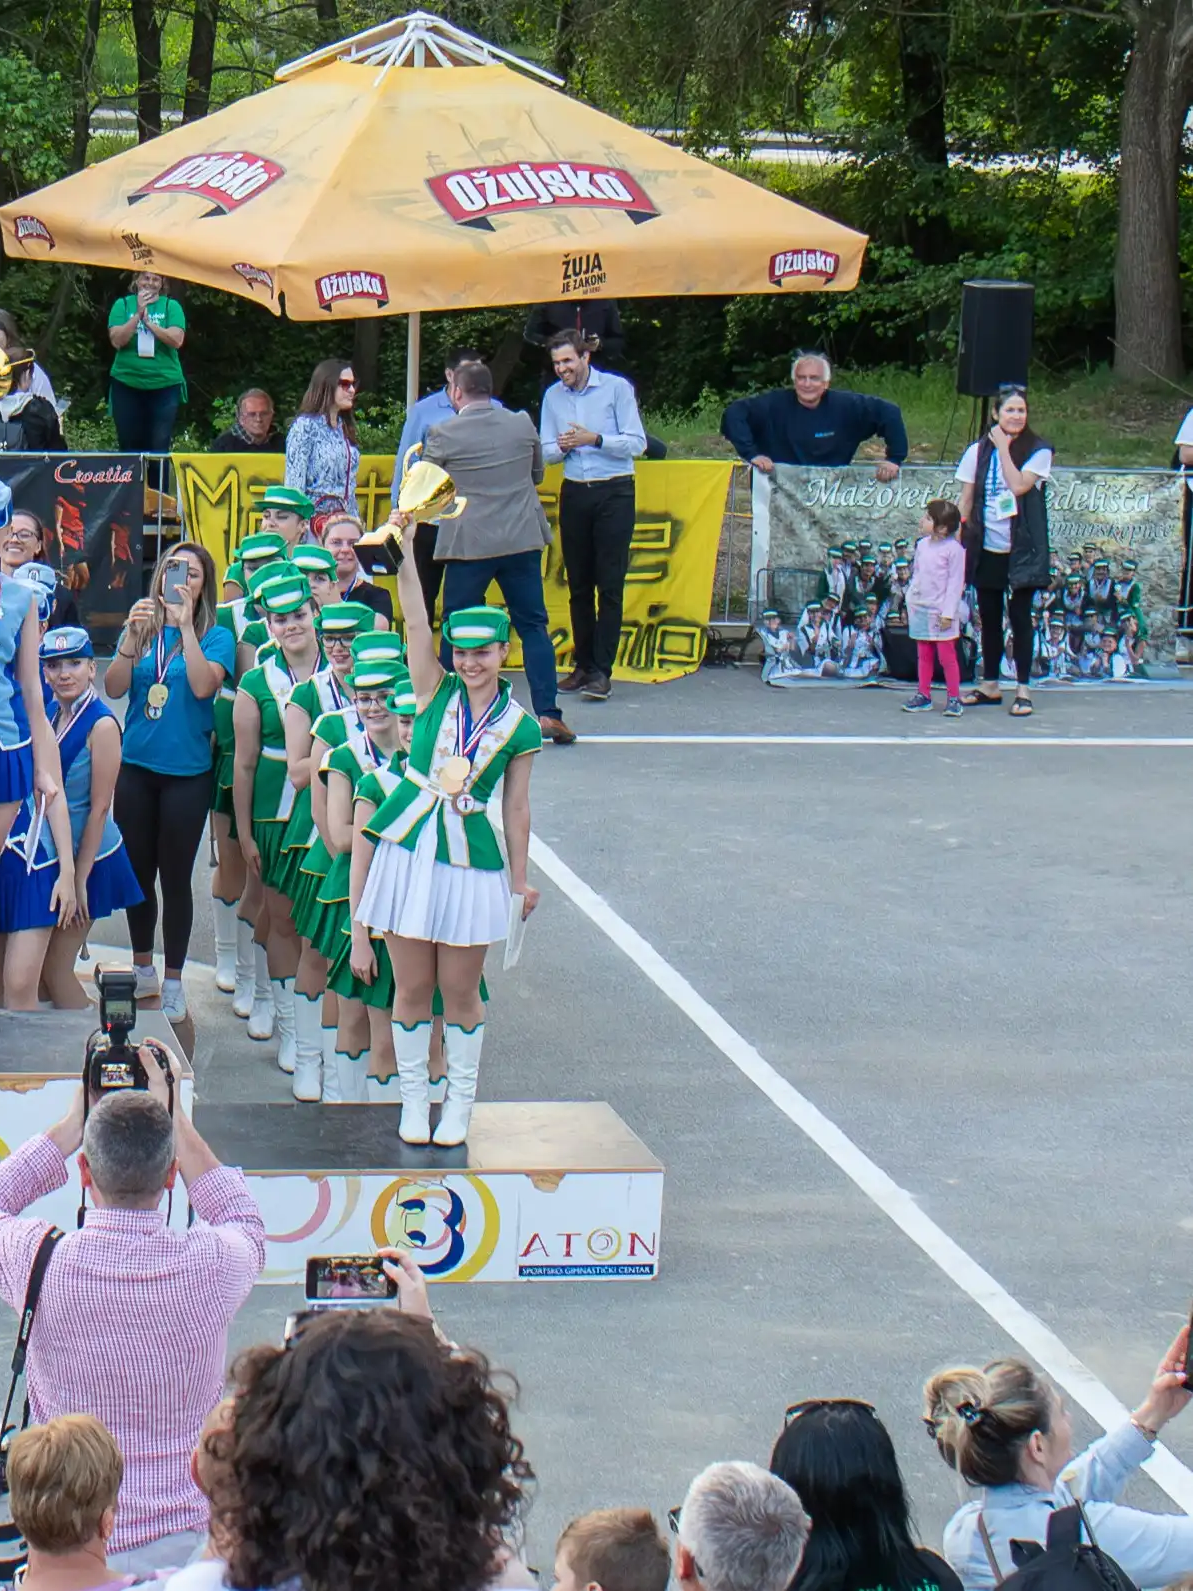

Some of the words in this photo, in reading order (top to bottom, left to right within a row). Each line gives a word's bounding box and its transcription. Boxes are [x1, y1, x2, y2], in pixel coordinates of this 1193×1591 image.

[445, 163, 634, 212] Ožujsko
[561, 252, 603, 280] ŽUJA
[774, 250, 835, 276] Ožujsko
[320, 272, 383, 300] Ožujsko
[561, 281, 571, 294] JE
[573, 272, 607, 290] ZAKON!
[54, 459, 133, 484] Croatia
[806, 478, 963, 508] Mažoretk
[1045, 480, 1152, 513] edelišća
[396, 1181, 465, 1276] 3
[518, 1226, 655, 1261] ATON
[618, 1265, 650, 1274] CENTAR
